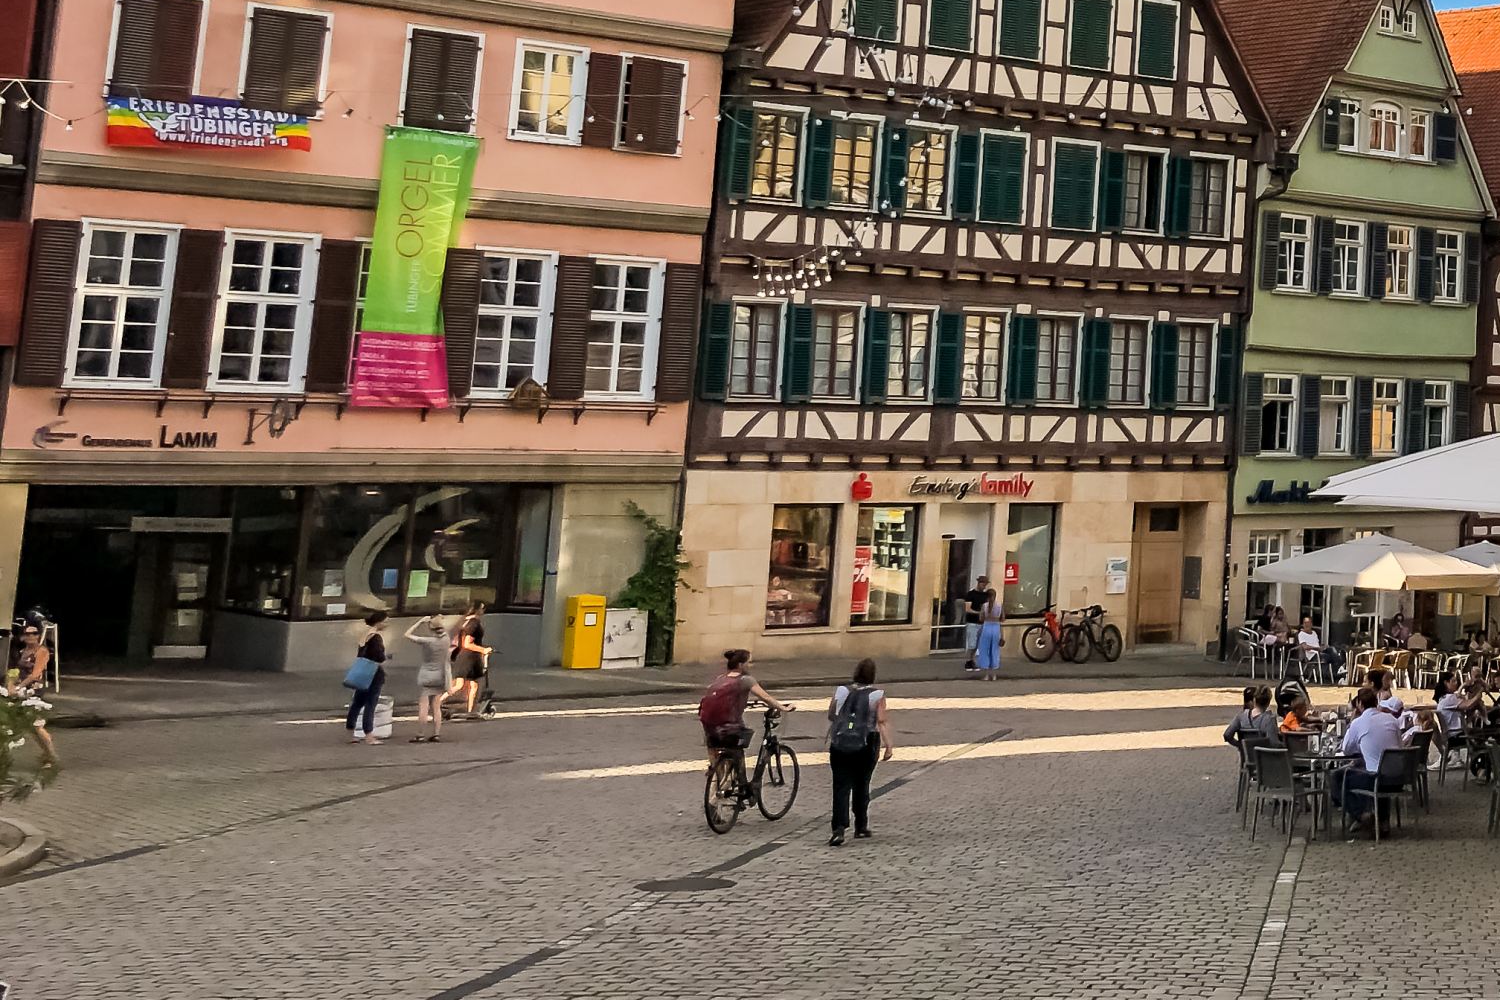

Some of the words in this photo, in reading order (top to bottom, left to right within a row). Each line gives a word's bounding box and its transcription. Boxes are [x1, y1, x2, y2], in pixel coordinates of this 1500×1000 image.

[180, 116, 276, 137] TÜBINGEN
[396, 157, 433, 257] ORGEL
[421, 154, 461, 293] SOMMER
[979, 471, 1034, 498] family
